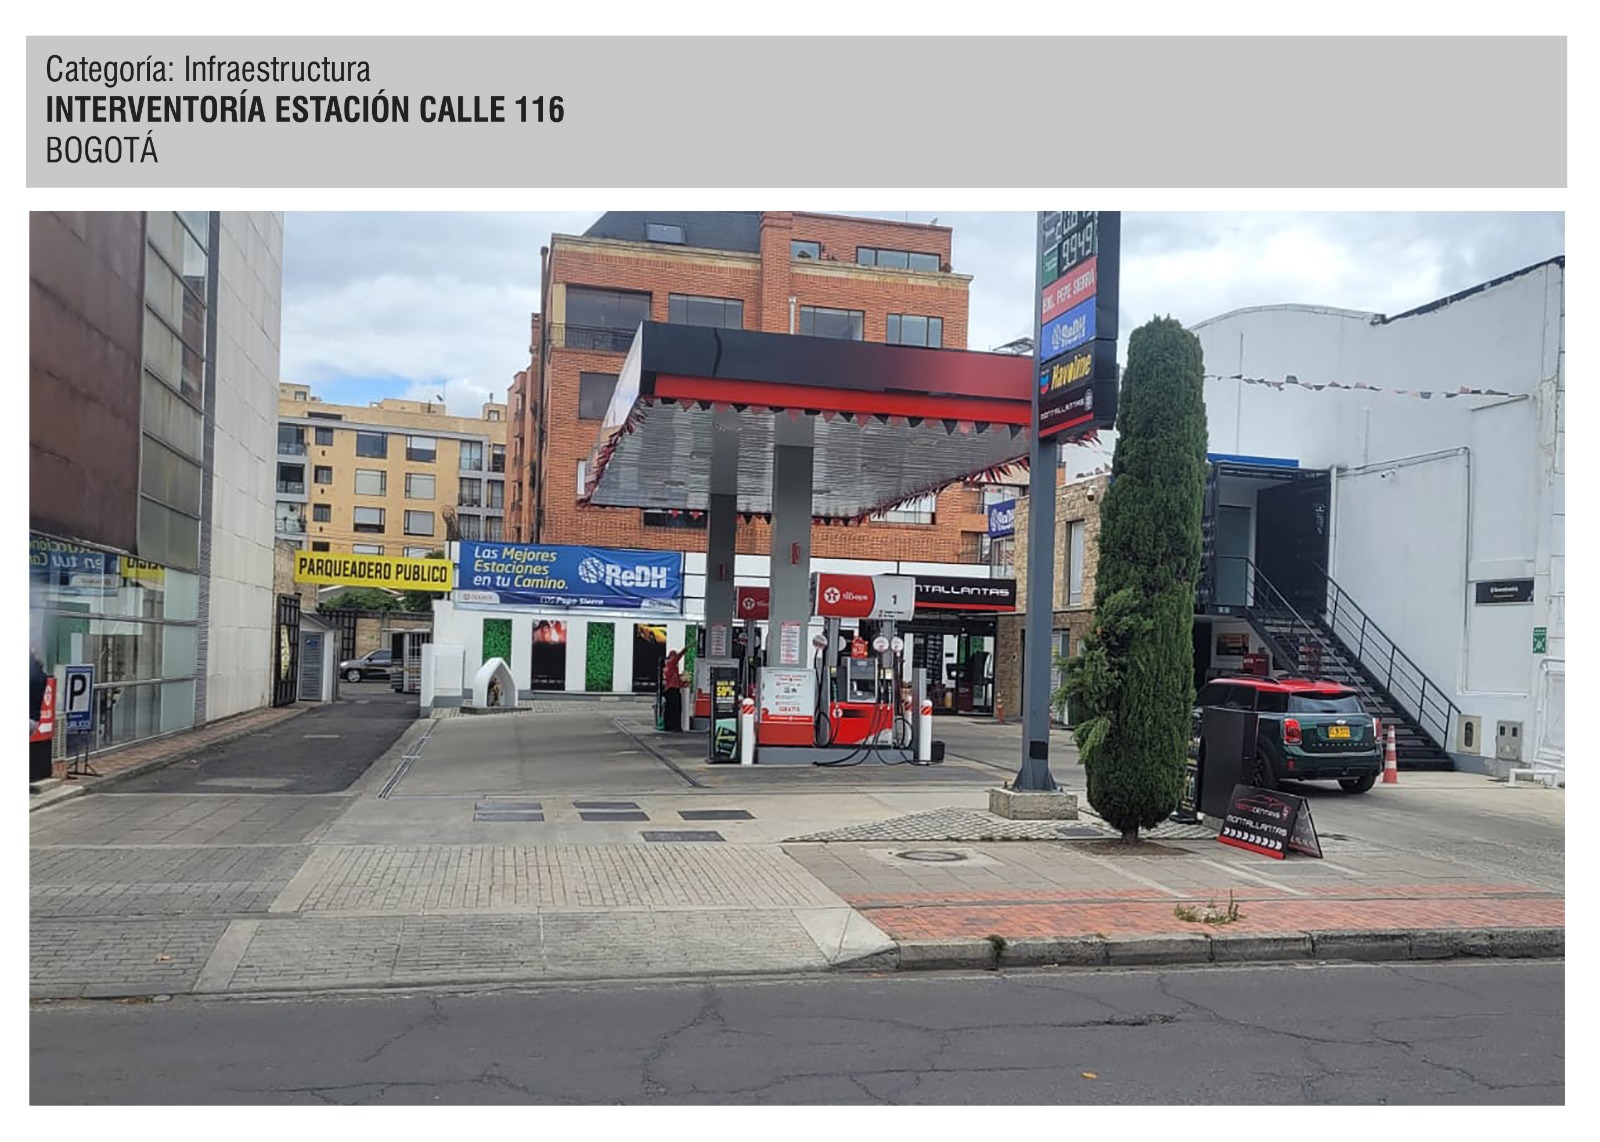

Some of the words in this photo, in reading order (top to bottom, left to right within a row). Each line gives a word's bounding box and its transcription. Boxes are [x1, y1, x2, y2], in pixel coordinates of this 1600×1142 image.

[1051, 353, 1092, 391] Havoline
[474, 545, 498, 559] Las
[502, 547, 558, 563] Mejores
[299, 557, 392, 581] PARQUEADERO
[395, 563, 448, 583] PUBLICO
[473, 559, 550, 575] Estaciones
[605, 563, 667, 589] ReDH
[473, 575, 491, 586] en
[496, 575, 510, 587] tu
[514, 574, 569, 590] Camino.
[915, 584, 1010, 597] NTALLANTAS
[891, 594, 898, 605] 1
[69, 673, 87, 711] P
